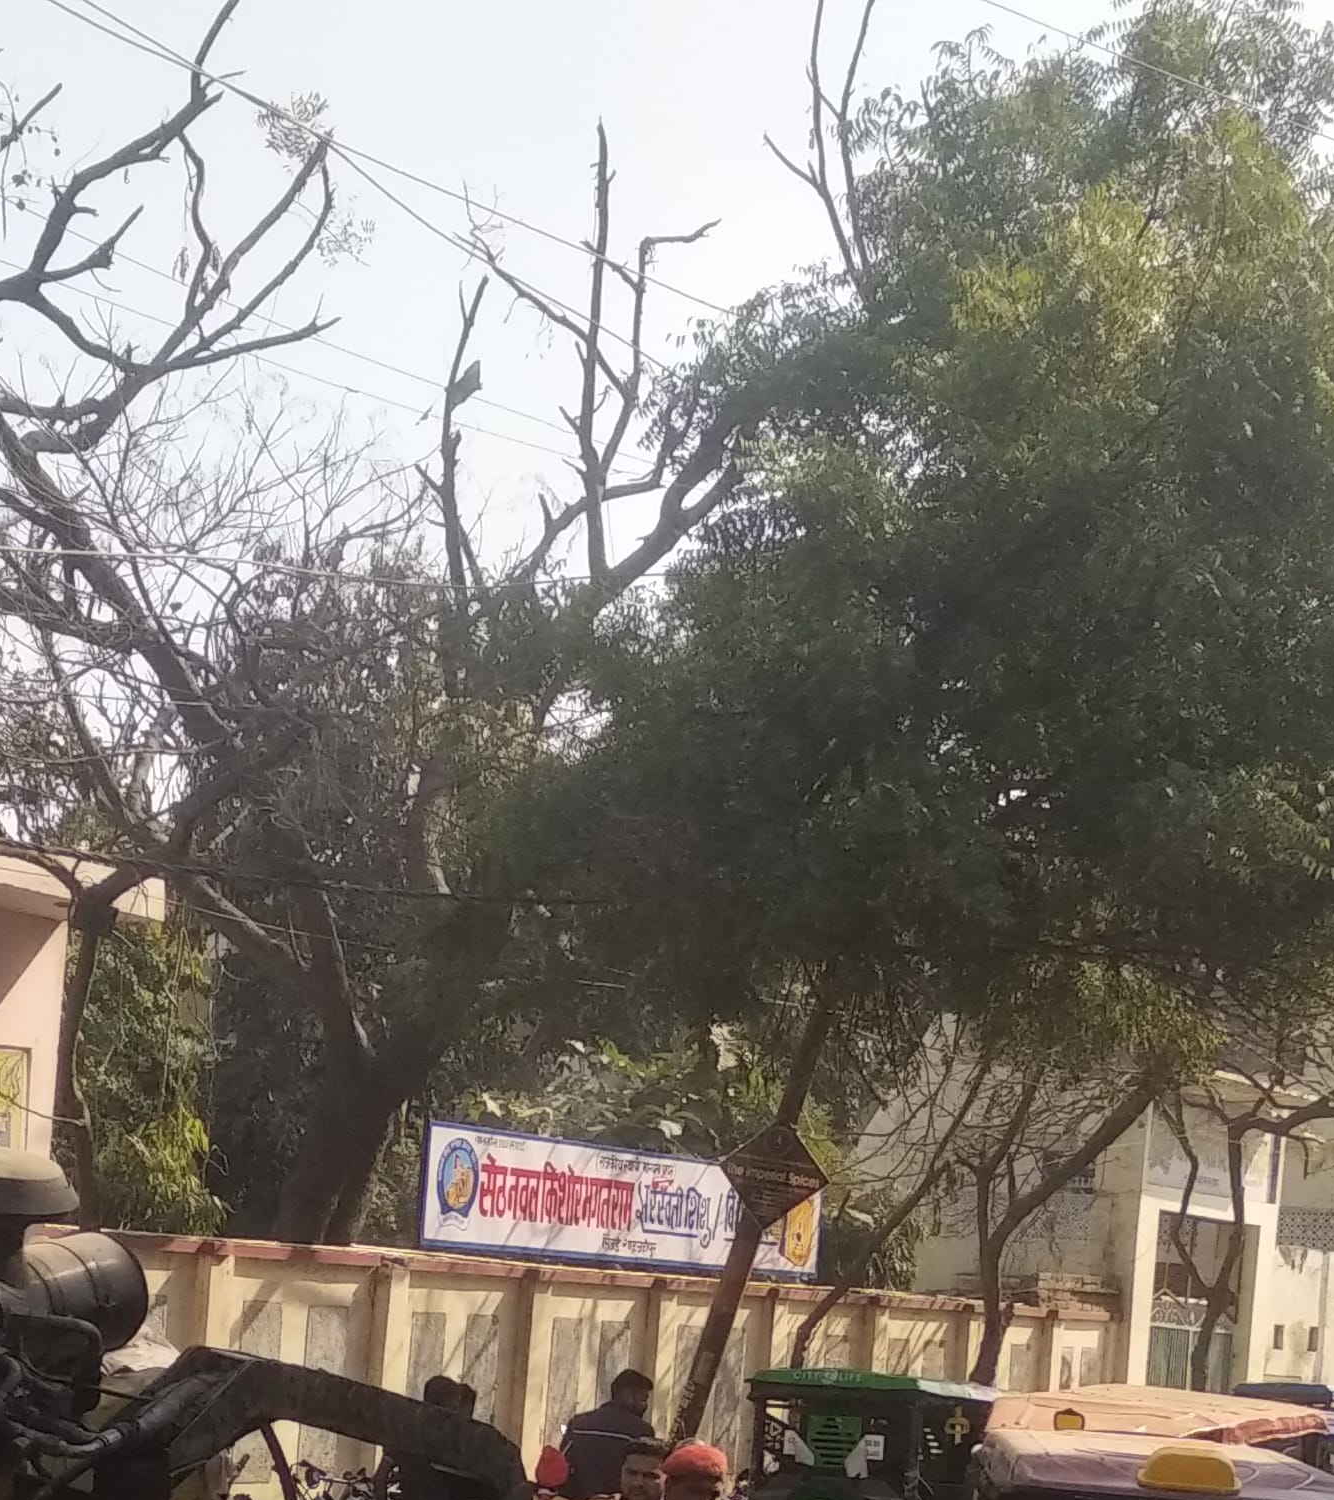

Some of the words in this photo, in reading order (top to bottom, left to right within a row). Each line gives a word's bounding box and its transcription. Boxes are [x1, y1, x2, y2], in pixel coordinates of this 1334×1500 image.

[726, 1162, 745, 1176] The
[478, 1152, 509, 1218] सेठ
[508, 1166, 541, 1222] नवल
[793, 1370, 819, 1380] CITY
[838, 1373, 862, 1383] LIFE
